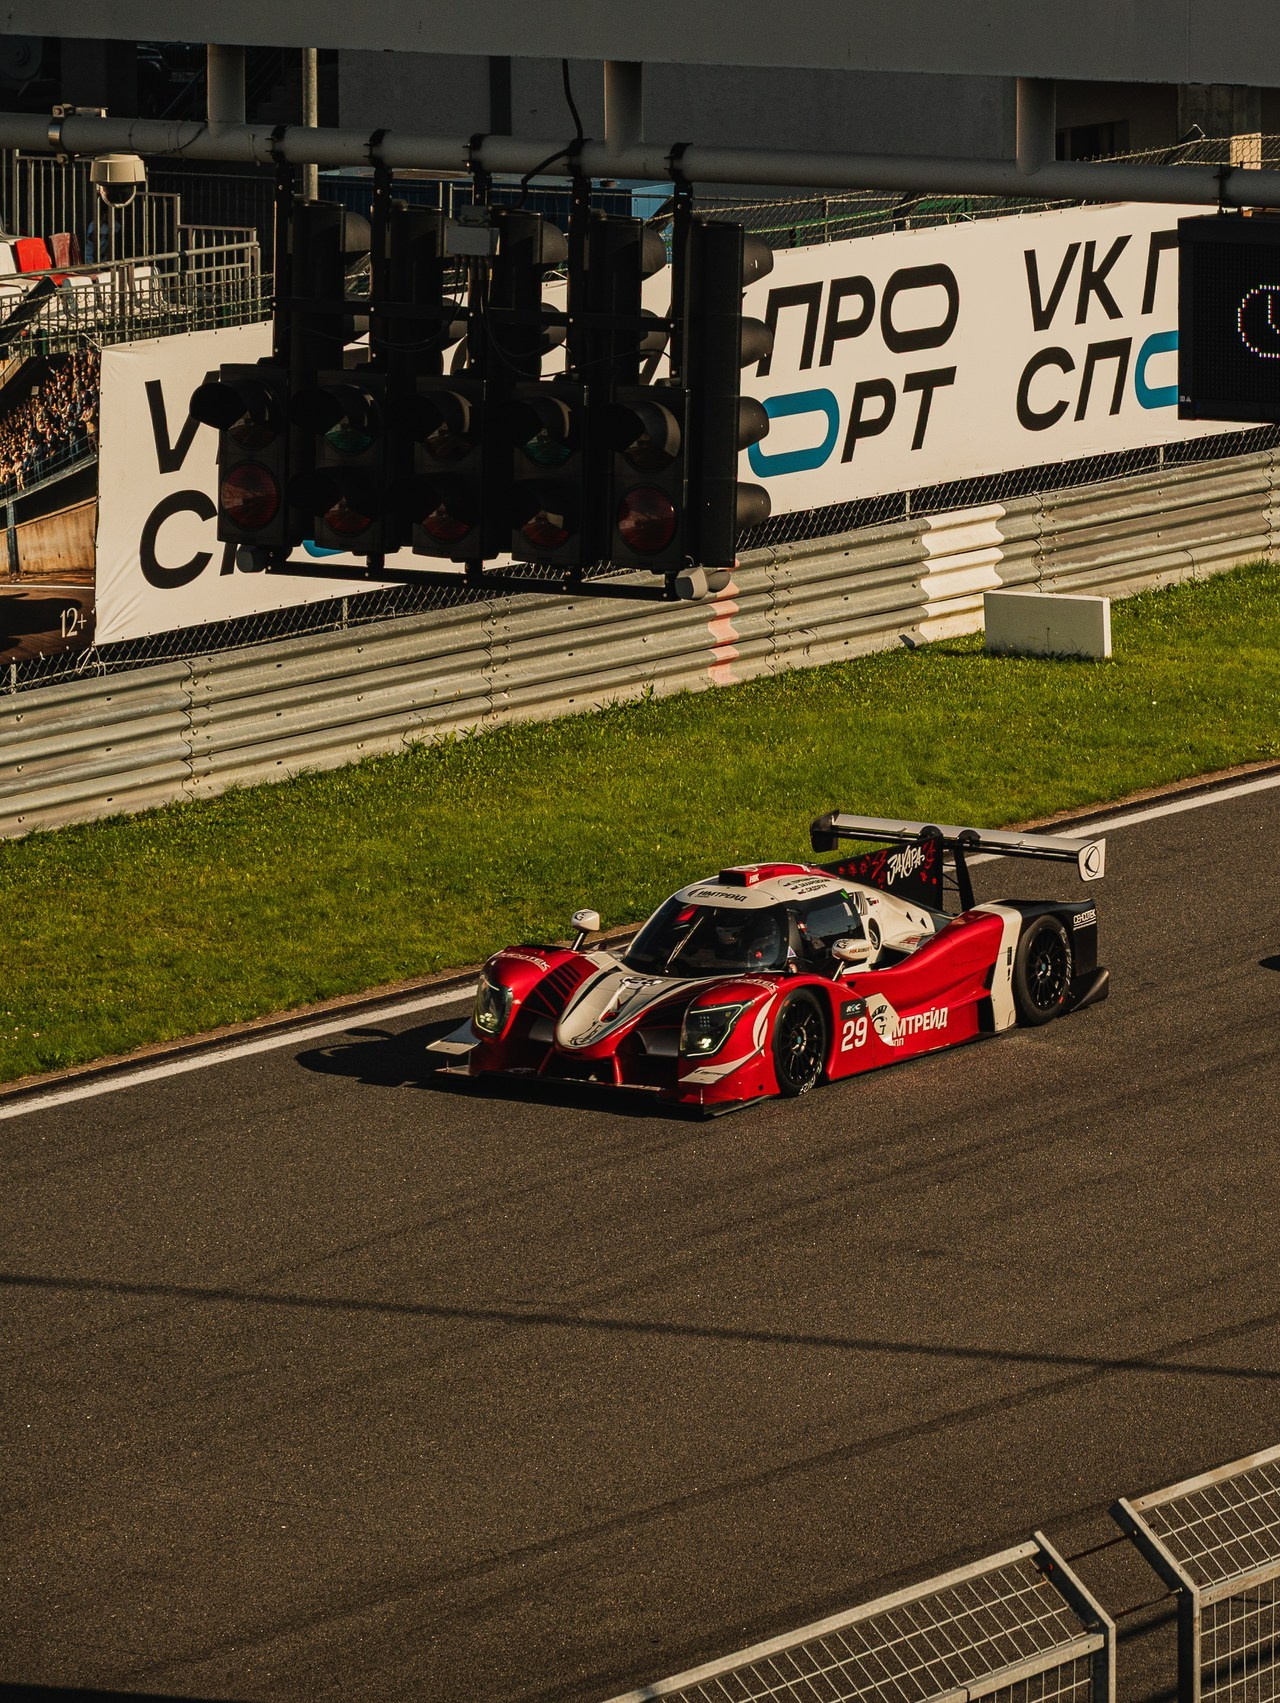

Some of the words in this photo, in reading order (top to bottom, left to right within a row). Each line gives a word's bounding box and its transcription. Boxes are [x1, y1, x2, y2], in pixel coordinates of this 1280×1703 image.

[756, 262, 959, 377] ПРО
[1024, 235, 1132, 331] VK
[747, 365, 957, 478] ОРТ
[1016, 330, 1179, 432] СПО
[60, 607, 87, 638] 12+
[841, 1016, 868, 1052] 29
[892, 1007, 949, 1039] МТРЕЙД
